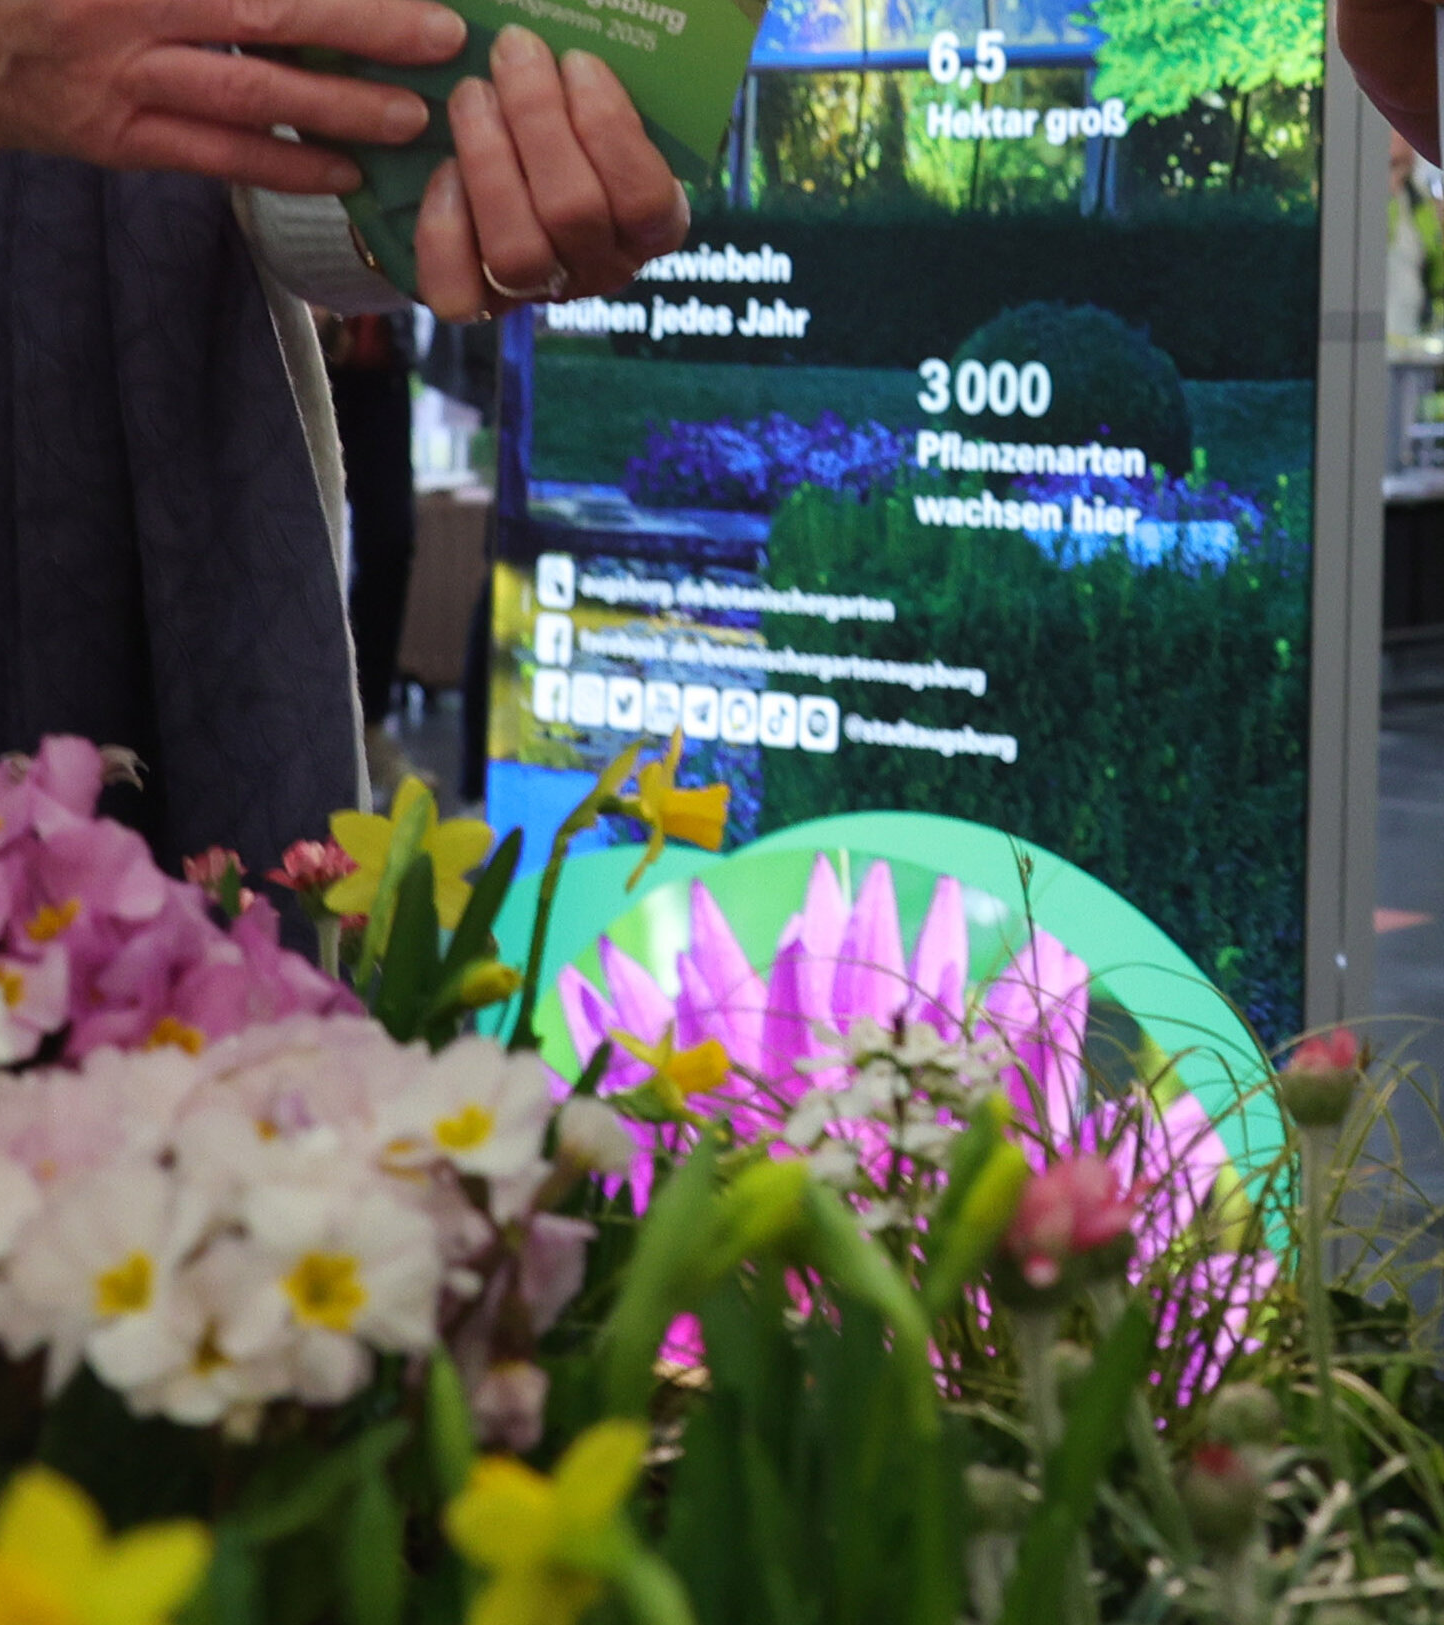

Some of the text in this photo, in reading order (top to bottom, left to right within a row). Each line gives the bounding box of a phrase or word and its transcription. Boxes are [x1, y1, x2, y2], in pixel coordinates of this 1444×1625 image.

[606, 19, 658, 53] 2025
[928, 29, 1008, 89] 6,5
[926, 98, 1128, 146] Hektar groß
[649, 293, 733, 341] jedes
[737, 296, 811, 338] Jahr
[917, 429, 1147, 478] Pflanzenarten
[914, 491, 1142, 537] wachsen hier
